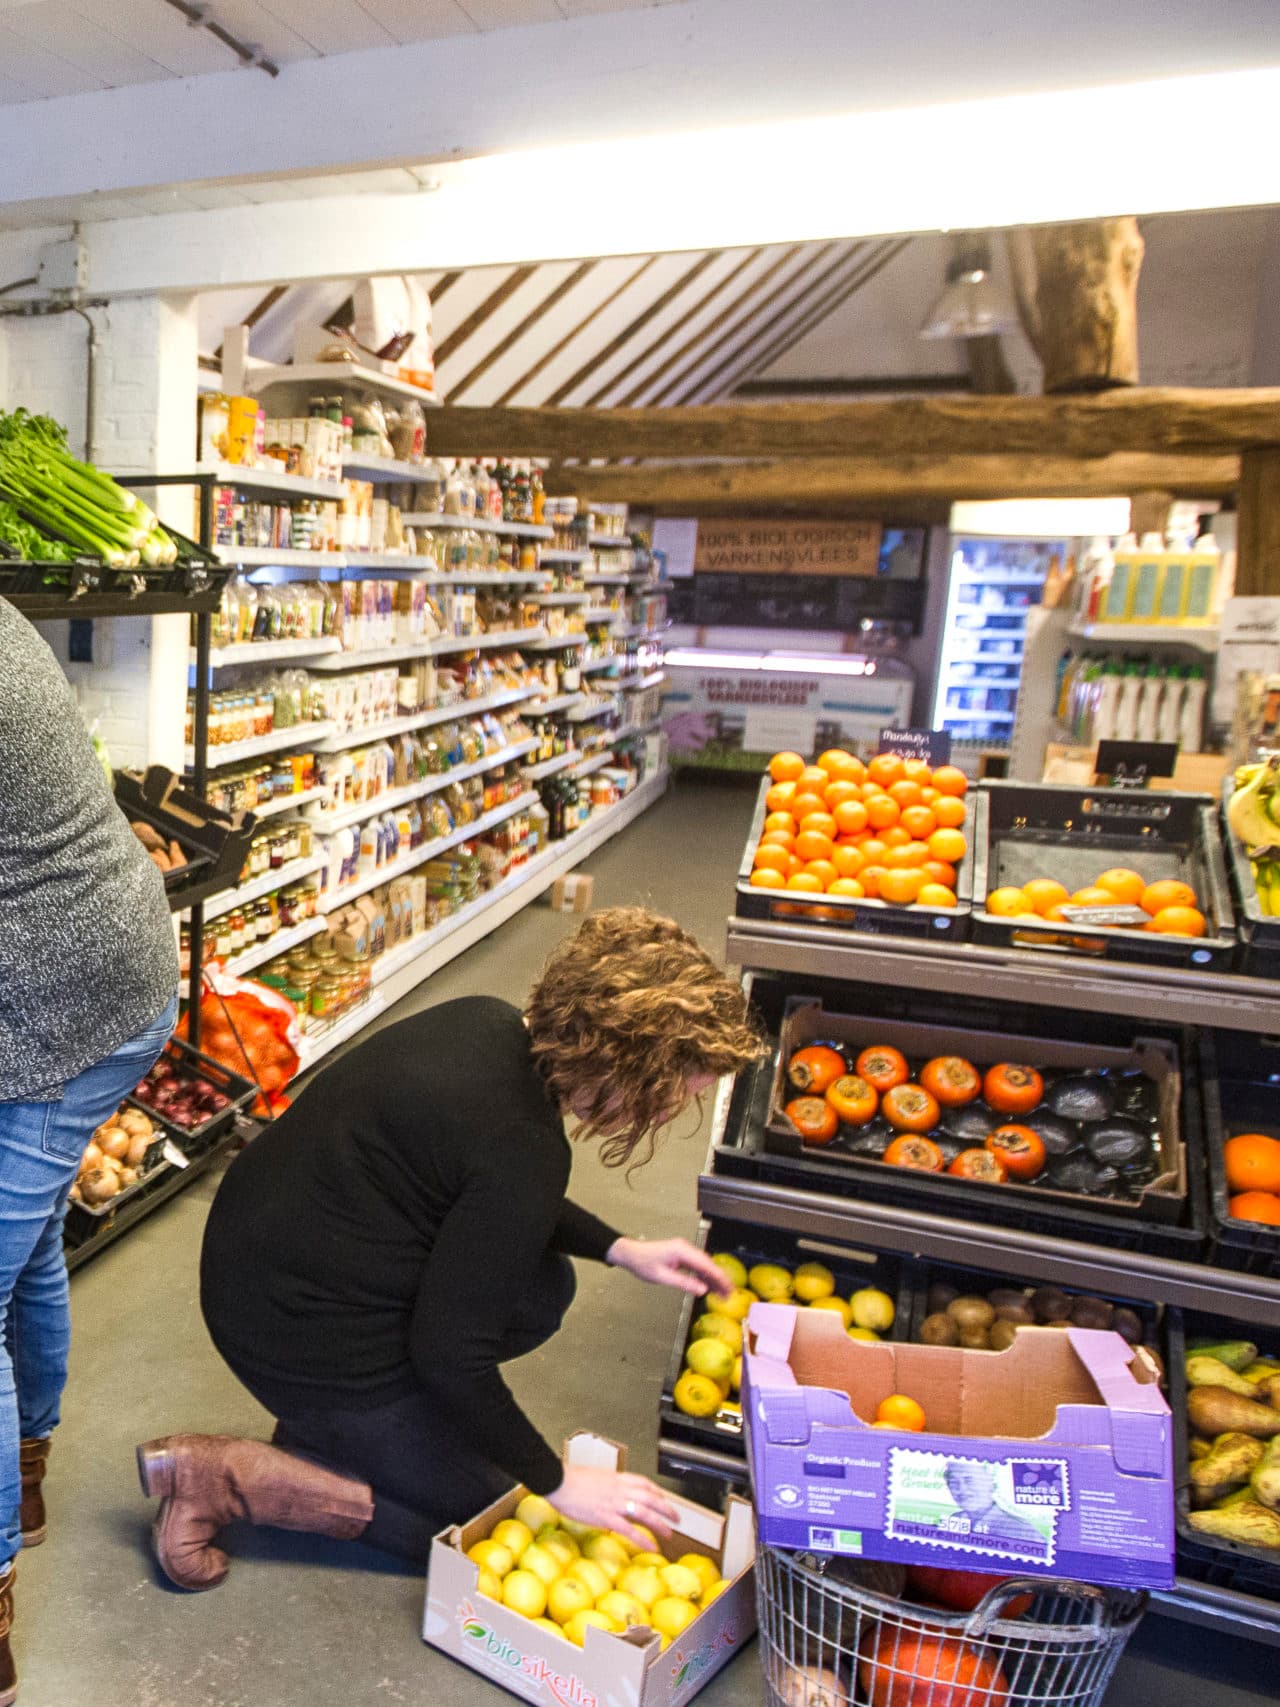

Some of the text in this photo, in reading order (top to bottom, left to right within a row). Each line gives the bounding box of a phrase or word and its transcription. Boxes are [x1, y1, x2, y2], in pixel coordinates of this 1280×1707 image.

[806, 1453, 882, 1468] Organic Produce
[1015, 1485, 1049, 1495] nature
[1015, 1493, 1061, 1506] more
[974, 1522, 990, 1534] at
[896, 1522, 1046, 1556] natureandmore.com
[486, 1631, 598, 1707] biosikelia
